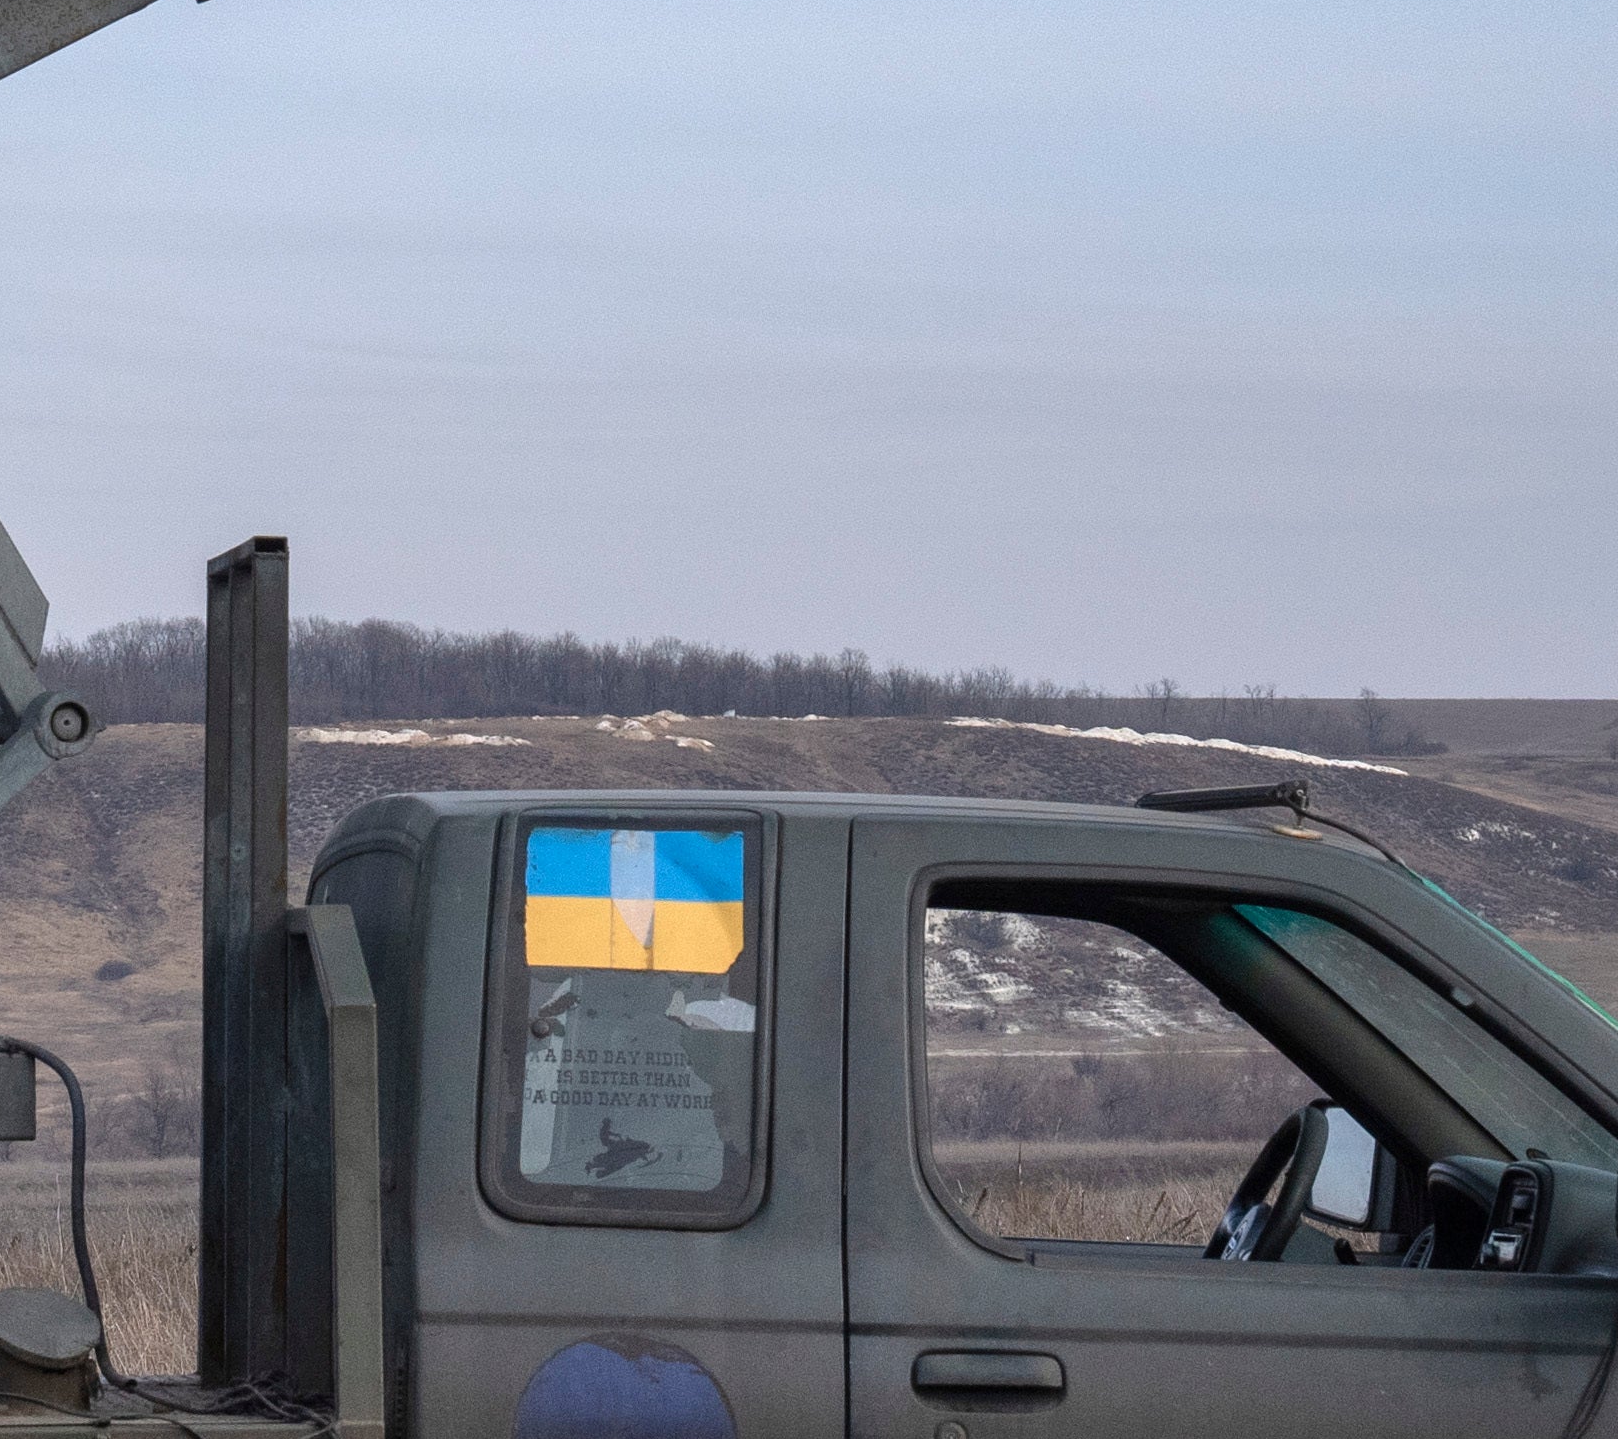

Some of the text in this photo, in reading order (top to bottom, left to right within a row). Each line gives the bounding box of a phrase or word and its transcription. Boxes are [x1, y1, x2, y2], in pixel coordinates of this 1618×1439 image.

[545, 1049, 693, 1067] A BAD DAY RIDIN
[557, 1070, 691, 1087] IS BETTER THAN
[533, 1090, 545, 1104] A
[551, 1090, 593, 1105] GOOD
[598, 1092, 632, 1107] DAY
[637, 1093, 659, 1107] AT
